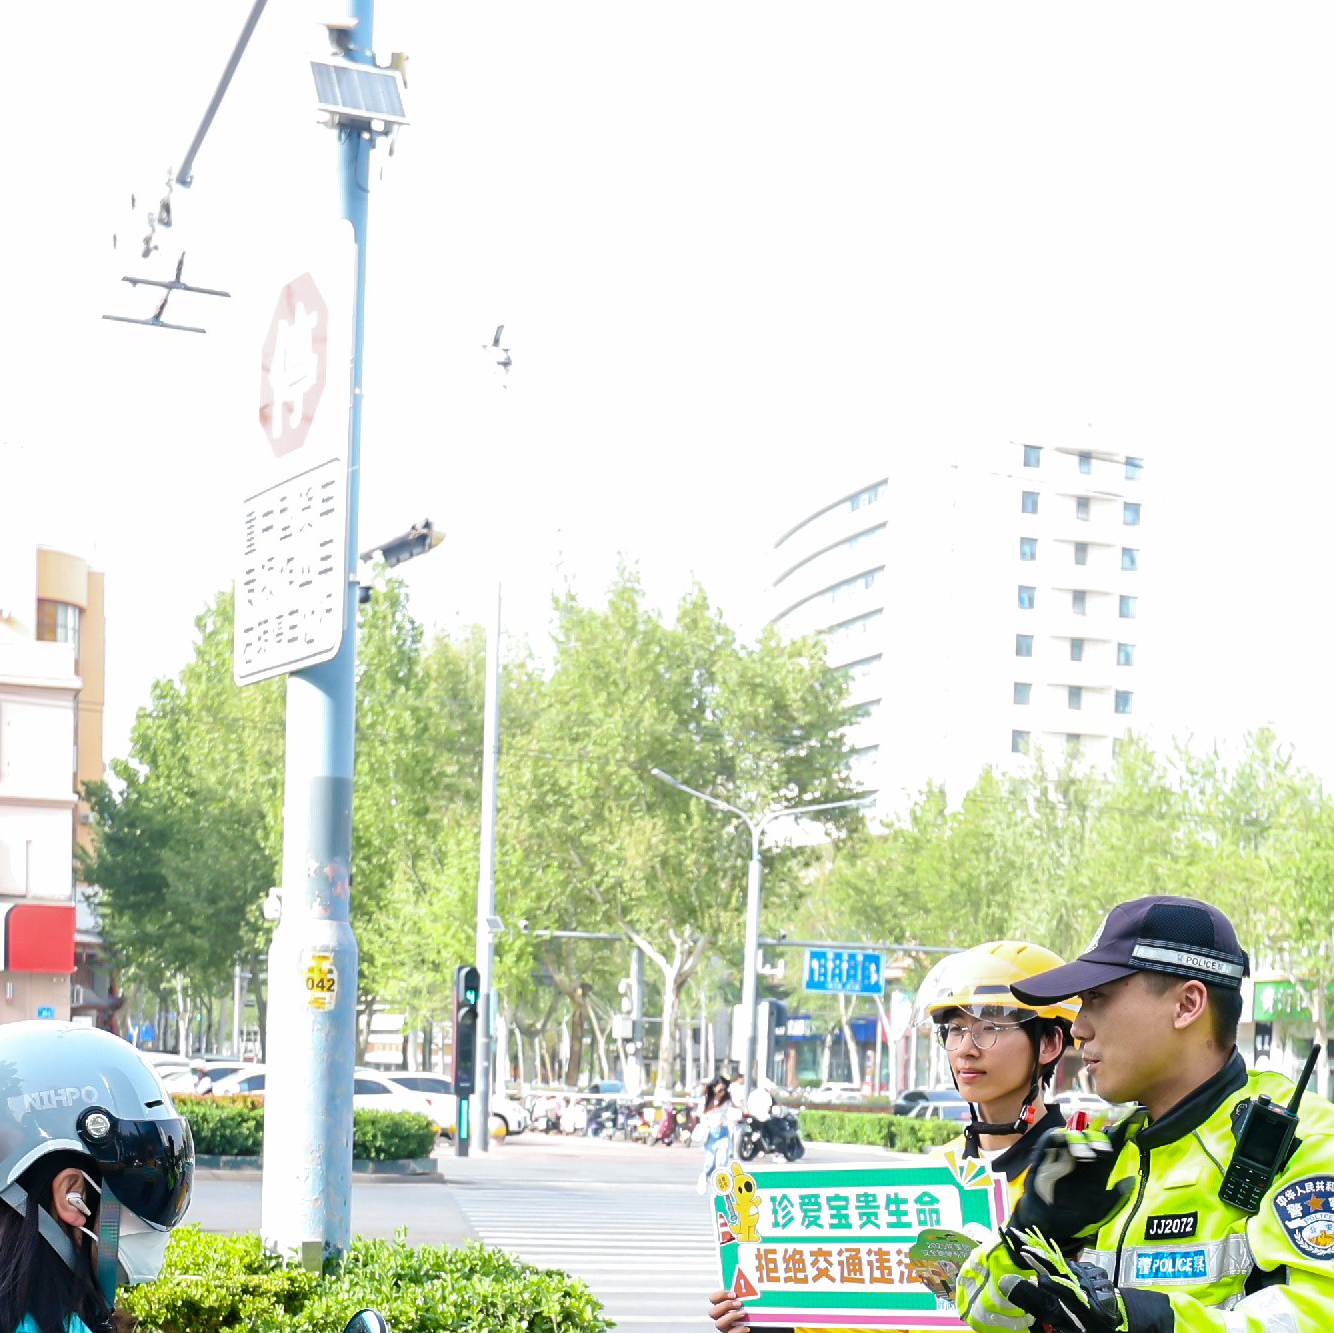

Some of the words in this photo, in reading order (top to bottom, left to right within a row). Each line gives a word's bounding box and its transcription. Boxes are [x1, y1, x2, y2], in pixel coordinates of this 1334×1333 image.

[1186, 956, 1217, 970] POLICE
[769, 1190, 941, 1231] 珍爱宝贵生命
[1149, 1216, 1194, 1235] JJ2072
